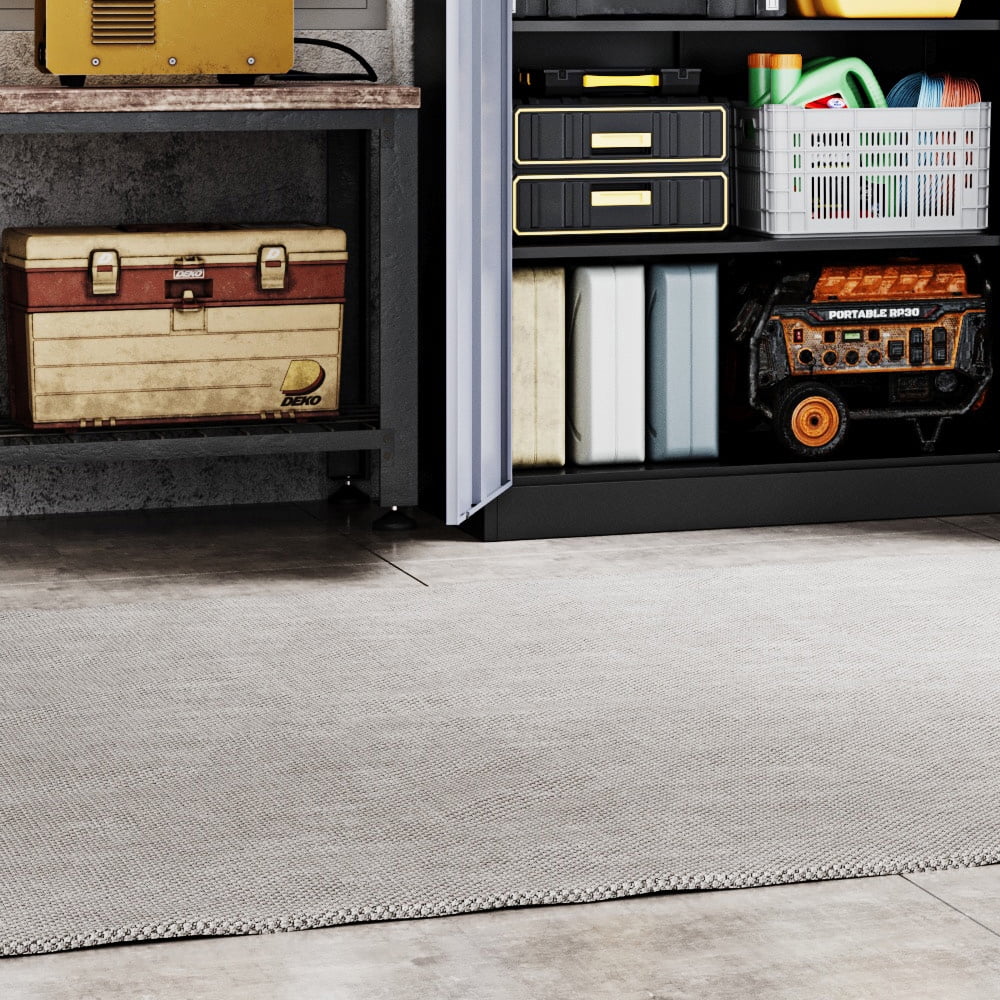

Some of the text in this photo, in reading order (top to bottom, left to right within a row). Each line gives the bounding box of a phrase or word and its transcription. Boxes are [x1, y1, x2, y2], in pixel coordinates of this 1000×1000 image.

[828, 307, 920, 320] PORTABLE RP30
[280, 395, 322, 407] DEKO
